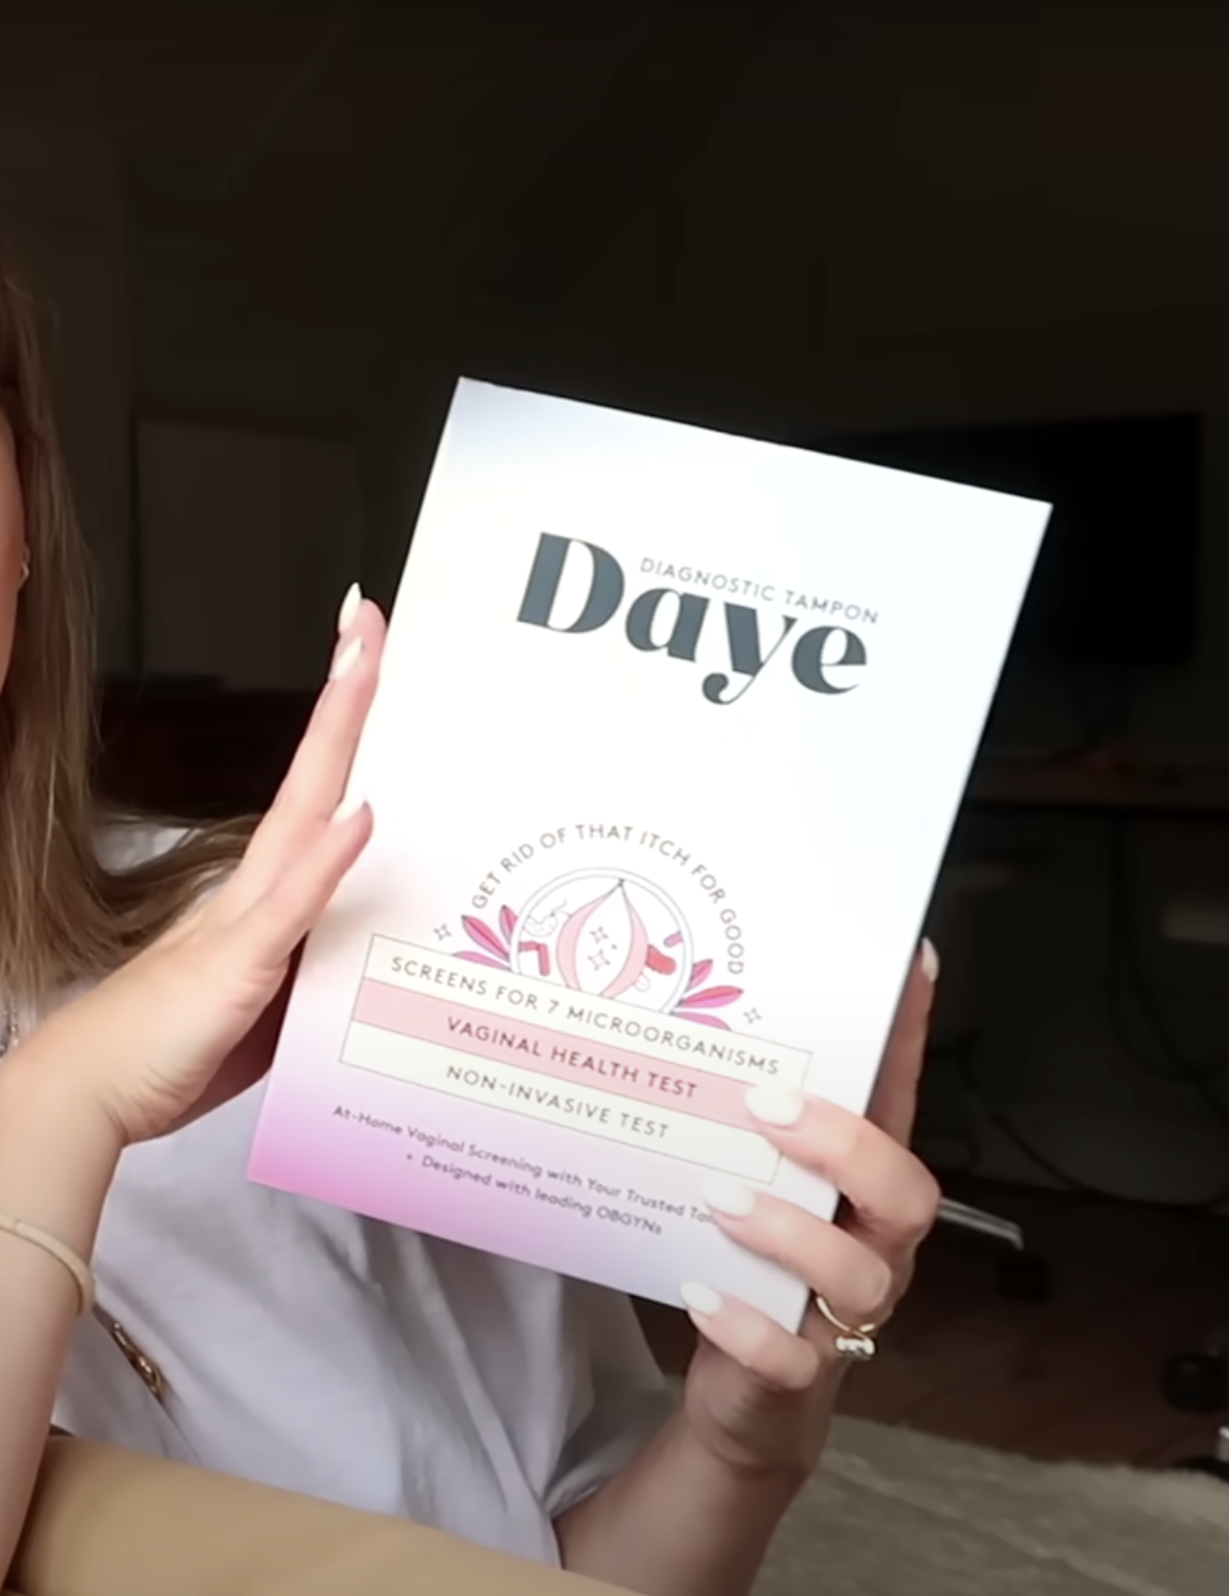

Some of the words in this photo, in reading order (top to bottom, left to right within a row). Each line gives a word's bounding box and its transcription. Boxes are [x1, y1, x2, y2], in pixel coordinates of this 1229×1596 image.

[516, 531, 867, 705] Daye
[640, 557, 775, 601] DIAGNOSTIC
[785, 590, 879, 624] TAMPON
[472, 871, 501, 909] GET
[500, 844, 534, 873] RID
[539, 828, 567, 849] OF
[575, 824, 633, 841] THAT
[639, 831, 691, 866] ITCH
[691, 865, 726, 904] FOR
[720, 909, 744, 974] GOOD
[391, 956, 488, 996] SCREENS
[495, 986, 538, 1011] FOR
[548, 999, 559, 1015] 7
[566, 1004, 779, 1075] MICROORGANISMS
[447, 1016, 542, 1057] VAGINAL
[550, 1046, 639, 1084] HEALTH
[648, 1071, 698, 1099] TEST
[446, 1065, 611, 1124] NON-INVASIVE
[619, 1113, 670, 1140] TEST
[333, 1105, 403, 1135] At-Home
[407, 1126, 465, 1154] Vaginal
[468, 1144, 542, 1179] Screening
[546, 1164, 582, 1187] with
[587, 1178, 622, 1200] Your
[626, 1189, 685, 1217] Trusted
[422, 1155, 492, 1187] Designed
[495, 1176, 531, 1198] with
[535, 1188, 593, 1218] leading
[597, 1206, 662, 1235] OBGYNs
